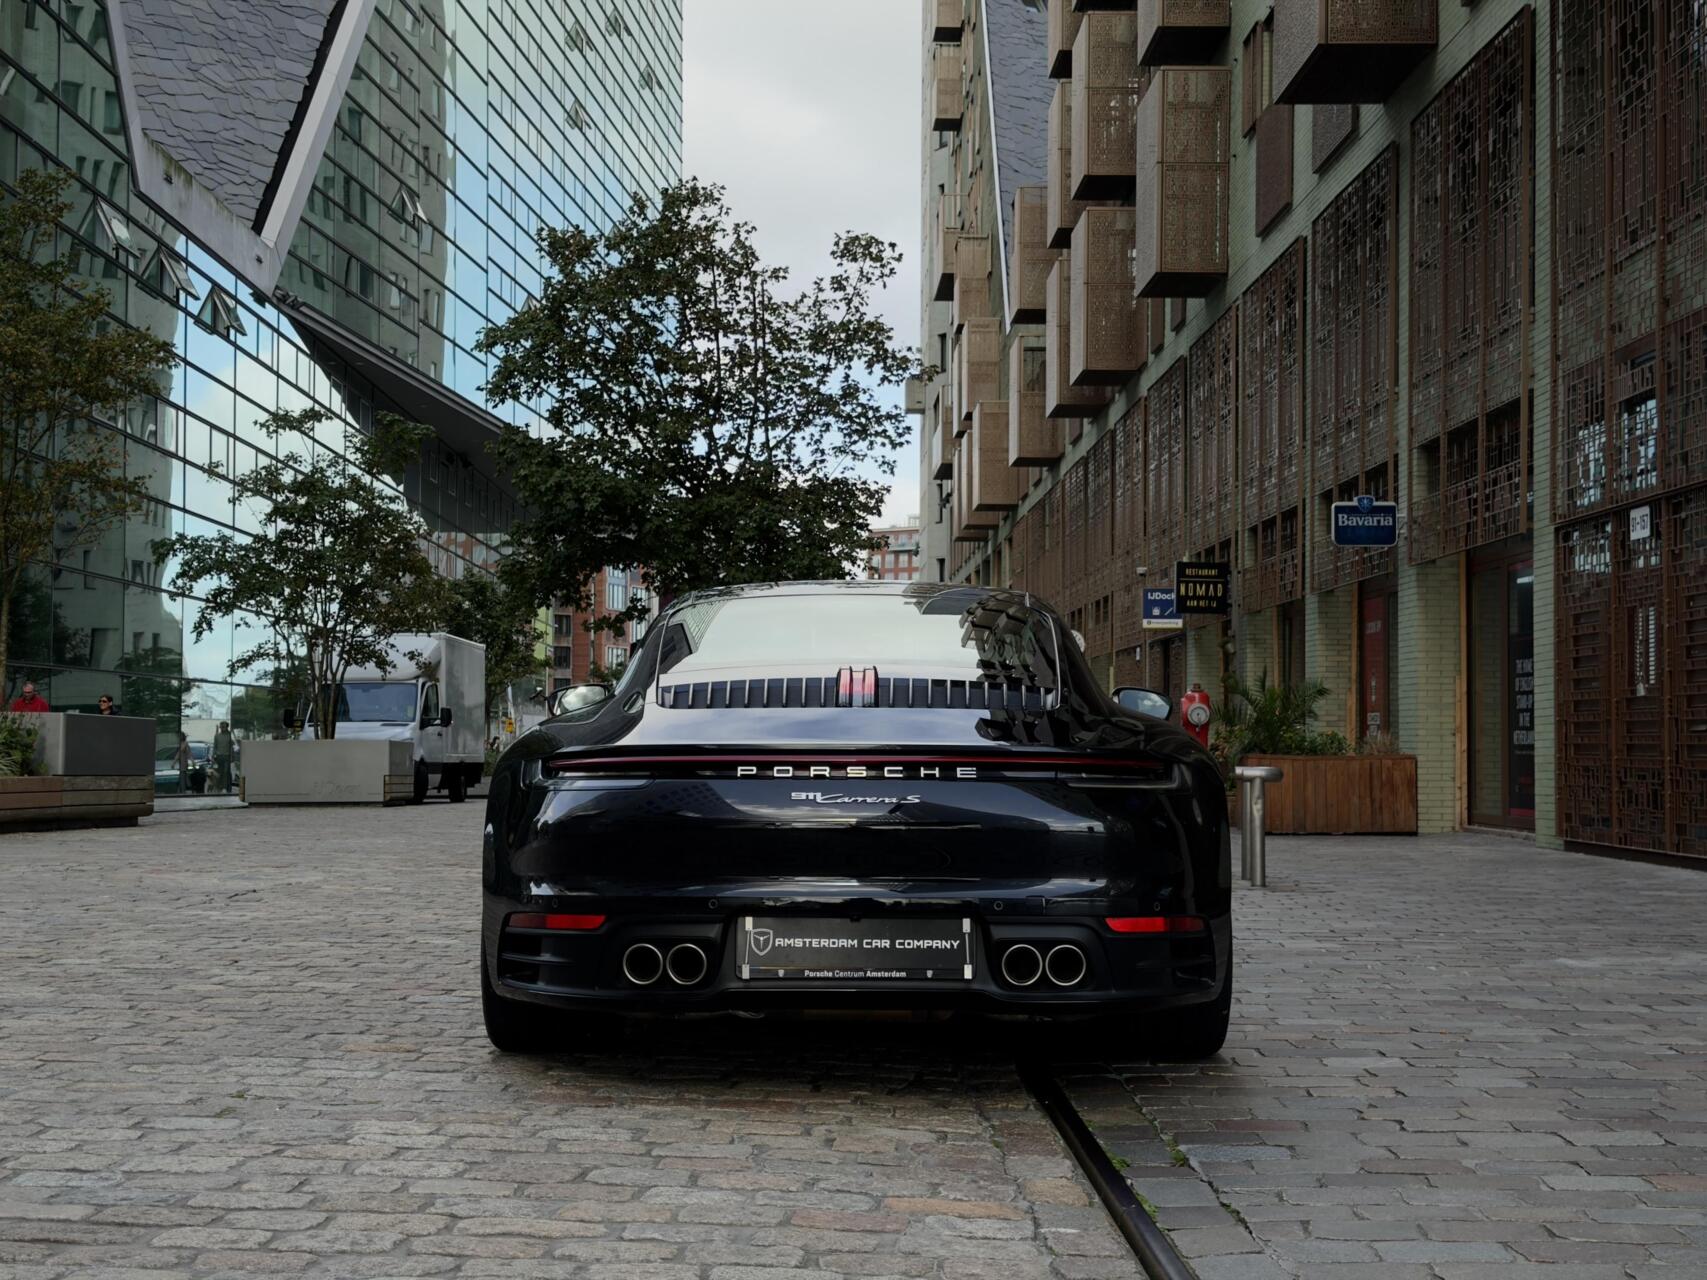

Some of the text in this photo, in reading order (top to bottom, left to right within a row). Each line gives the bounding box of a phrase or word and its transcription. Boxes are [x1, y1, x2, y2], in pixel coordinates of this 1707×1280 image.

[1338, 513, 1393, 526] Bavaria
[1185, 568, 1218, 576] RESTAURANT
[1180, 583, 1223, 597] NOMAD
[737, 766, 977, 778] PORSCHE
[791, 792, 921, 804] 911 Carrera S
[775, 938, 960, 949] AMSTERDAM CAR COMPANY
[804, 970, 907, 978] Porsche Centrum Amsterdam
